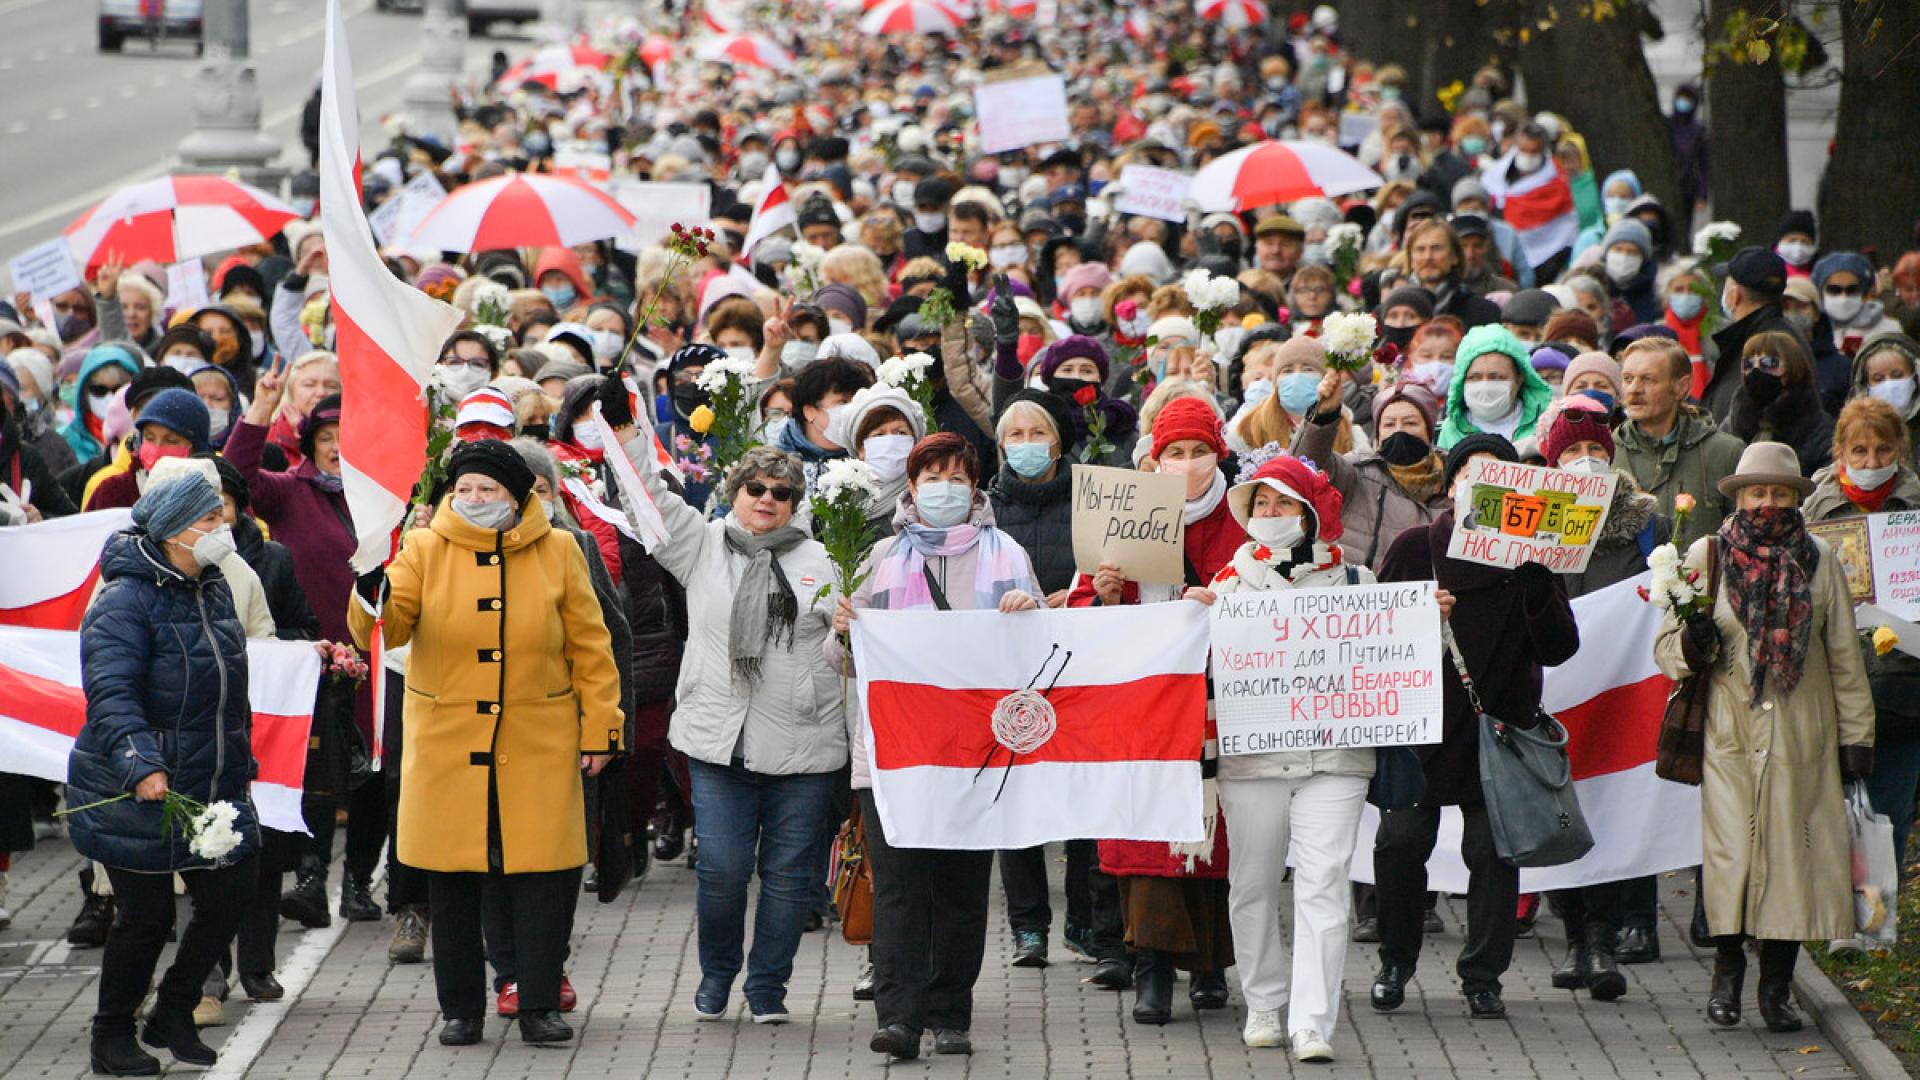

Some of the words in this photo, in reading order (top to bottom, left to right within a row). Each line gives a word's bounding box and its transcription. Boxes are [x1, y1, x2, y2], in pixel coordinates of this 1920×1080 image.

[1476, 461, 1537, 489] ХВАТИТ
[1541, 471, 1608, 497] КОРМИТЬ
[1103, 506, 1183, 548] рабы!
[1507, 504, 1538, 529] БТ
[1564, 519, 1594, 537] ОНТ
[1461, 532, 1501, 561] НАС
[1293, 584, 1429, 614] ПРОМАХНУЛСЯ!
[1222, 675, 1290, 699] КРАСИТЬ
[1292, 674, 1347, 696] ФАСАД
[1290, 690, 1400, 721] КРОВЬЮ
[1222, 735, 1242, 754] ЕЕ
[1335, 717, 1428, 748] ДОЧЕРЕЙ!
